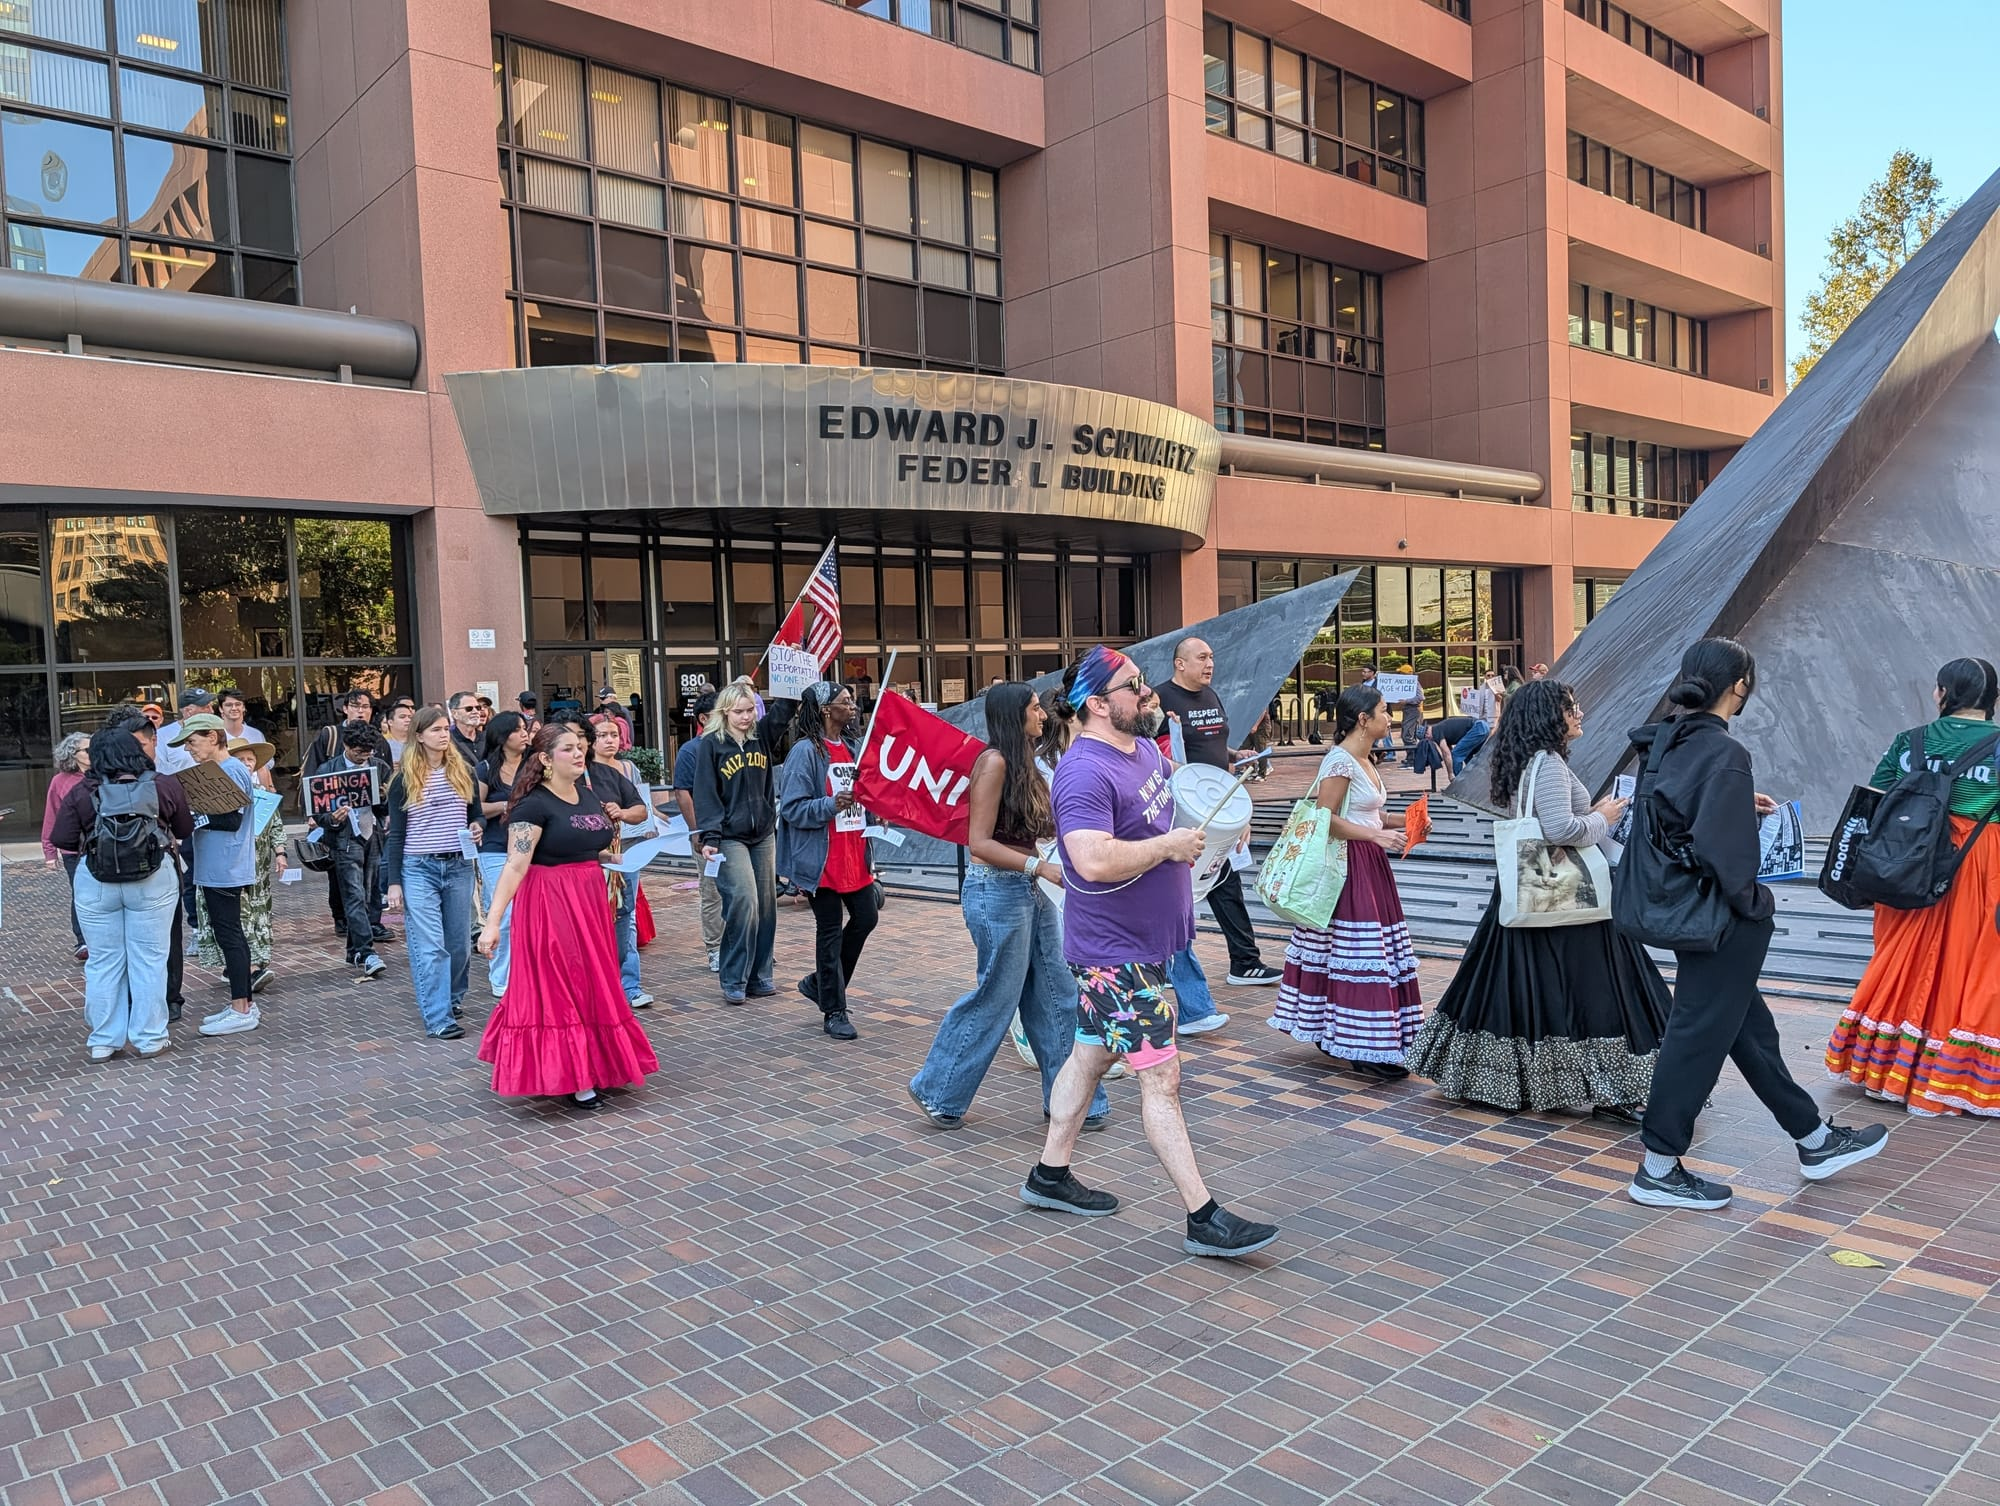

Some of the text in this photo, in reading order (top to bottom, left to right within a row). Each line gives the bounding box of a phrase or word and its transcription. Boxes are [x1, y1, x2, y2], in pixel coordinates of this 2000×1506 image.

[819, 405, 1199, 475] EDWARD J. SCHWARTZ
[898, 454, 1166, 501] FEDERL BUILDING
[771, 646, 813, 666] STOP THE
[681, 673, 706, 687] 880
[1188, 708, 1219, 719] RESPECT
[1191, 717, 1224, 727] OUR WORK
[336, 788, 346, 796] LA
[1138, 769, 1163, 803] NOW IS
[1142, 785, 1172, 824] THE TIM
[1831, 817, 1859, 881] Goodwill
